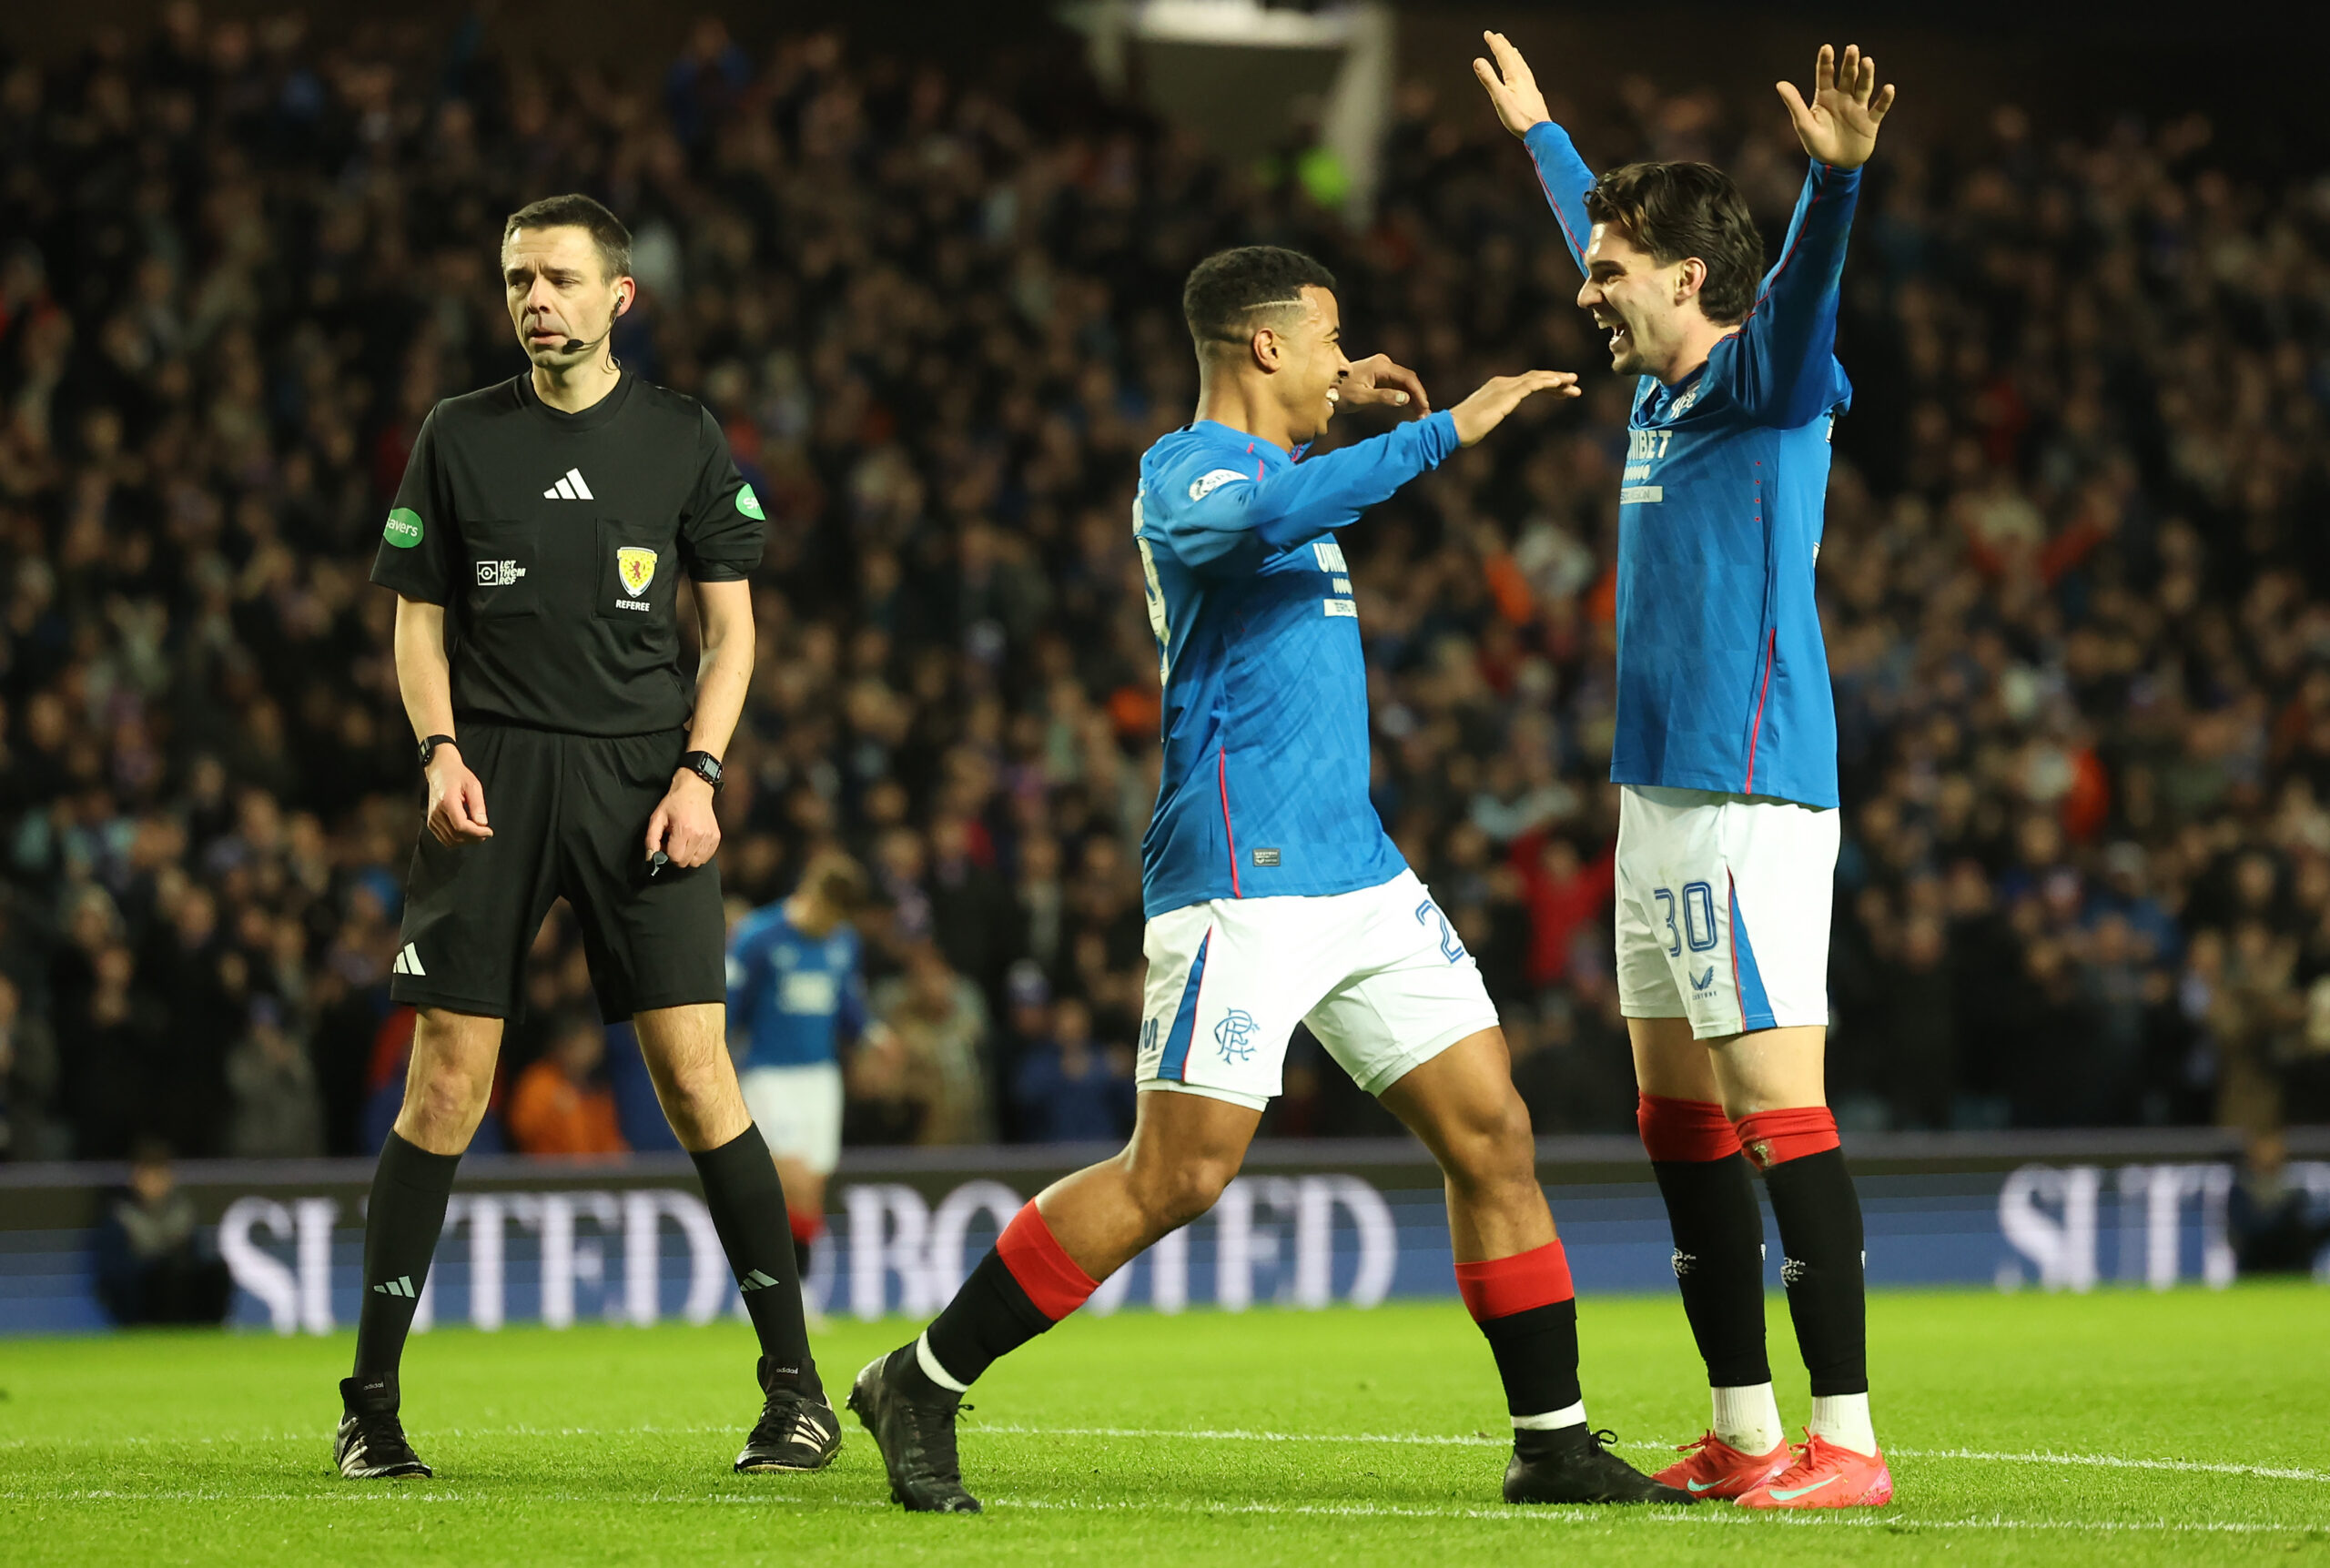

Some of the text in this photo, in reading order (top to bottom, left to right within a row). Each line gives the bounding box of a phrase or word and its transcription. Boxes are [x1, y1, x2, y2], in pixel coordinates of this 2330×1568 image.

[499, 561, 517, 569] LET
[499, 568, 526, 577] THEM
[498, 576, 517, 585] REF
[615, 599, 651, 612] REFEREE
[1653, 881, 1717, 957] 30
